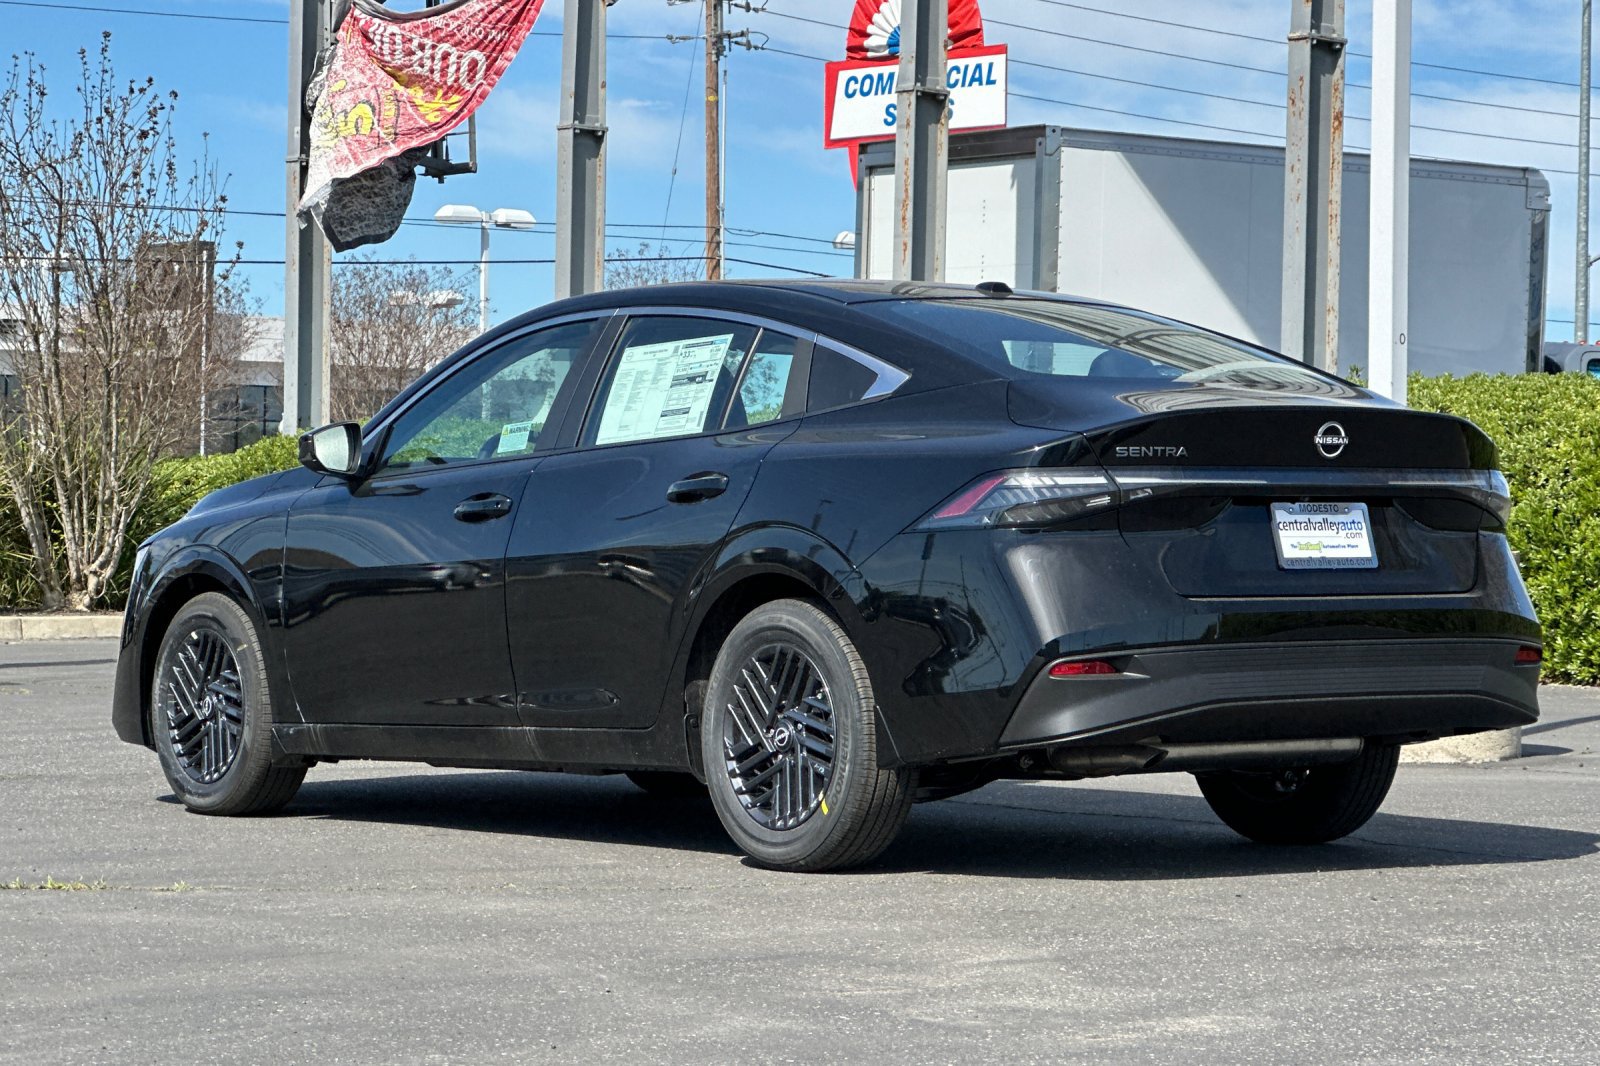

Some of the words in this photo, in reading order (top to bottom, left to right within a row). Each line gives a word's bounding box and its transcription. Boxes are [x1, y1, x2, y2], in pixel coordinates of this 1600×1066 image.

[844, 62, 997, 99] COMCIAL
[1315, 435, 1349, 444] NISSAN
[1116, 446, 1188, 457] SENTRA
[1299, 504, 1340, 513] MODESTO
[1278, 518, 1363, 534] centralvalleyauto
[1286, 556, 1374, 567] centralvalleyauto.com
